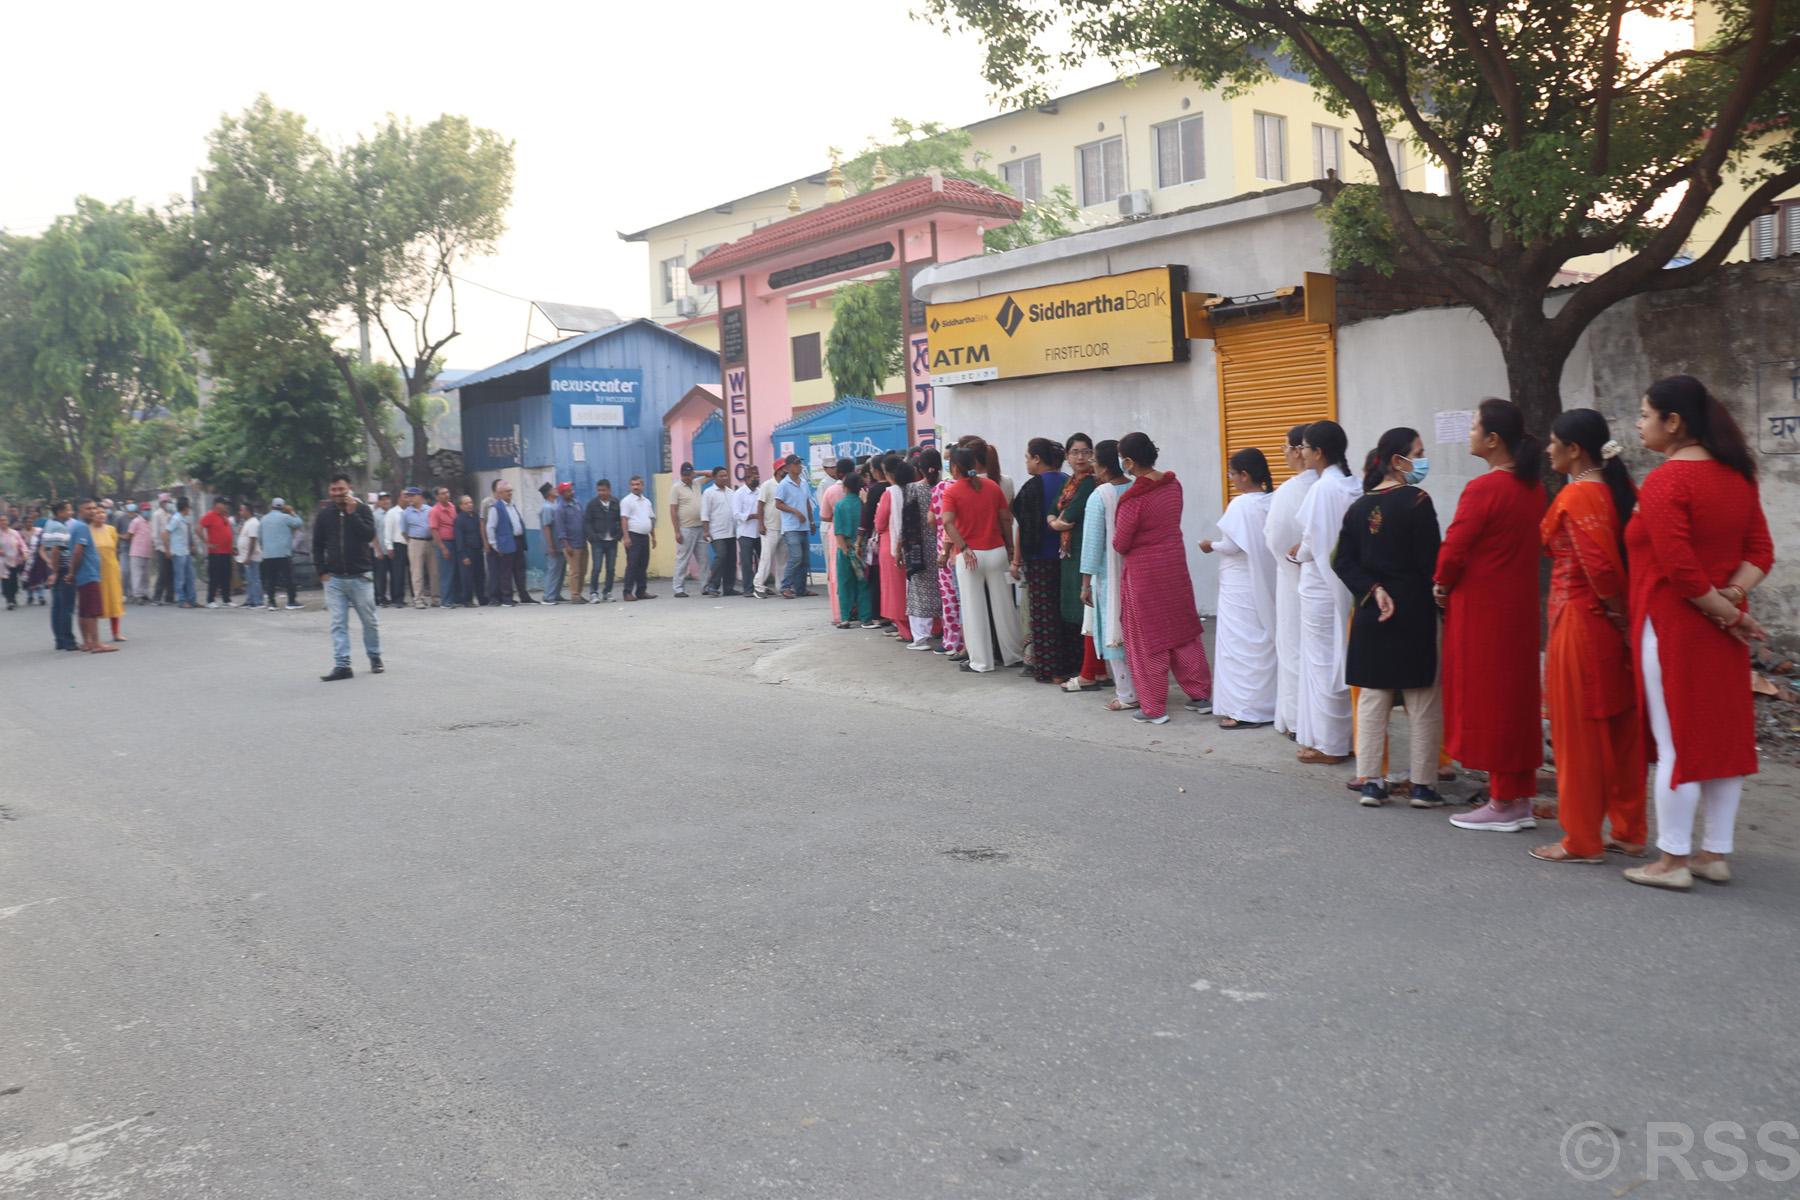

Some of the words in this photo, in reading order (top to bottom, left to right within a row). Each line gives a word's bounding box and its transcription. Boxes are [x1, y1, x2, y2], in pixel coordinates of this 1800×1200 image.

[1029, 287, 1167, 323] SiddharthaBank
[933, 344, 990, 368] ATM
[551, 378, 636, 393] nexuscenter
[728, 371, 748, 490] WELCO
